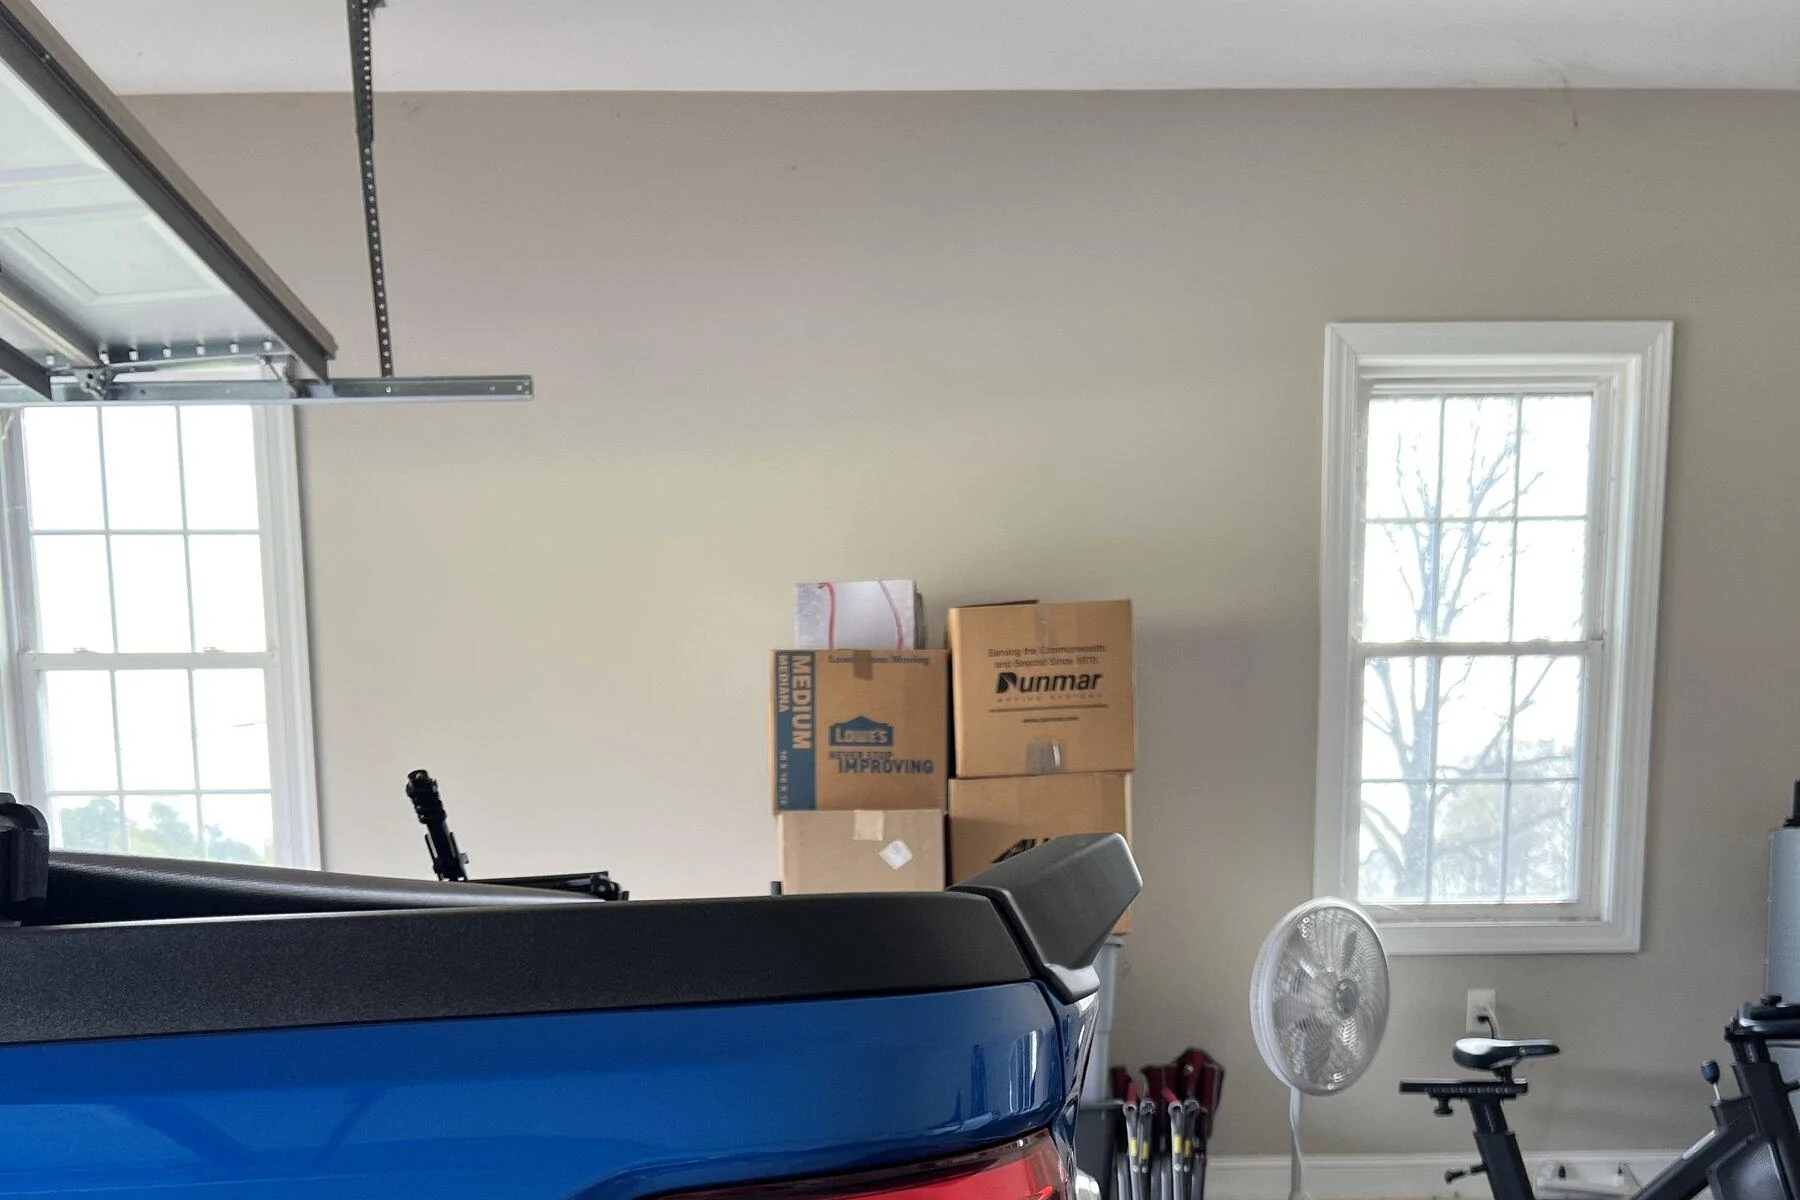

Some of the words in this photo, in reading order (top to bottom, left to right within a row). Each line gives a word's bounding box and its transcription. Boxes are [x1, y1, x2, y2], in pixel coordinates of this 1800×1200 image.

[778, 654, 790, 713] MEDIANA
[791, 655, 812, 750] MEDIUM
[996, 672, 1104, 694] Dunmar
[838, 760, 934, 774] IMPROVING
